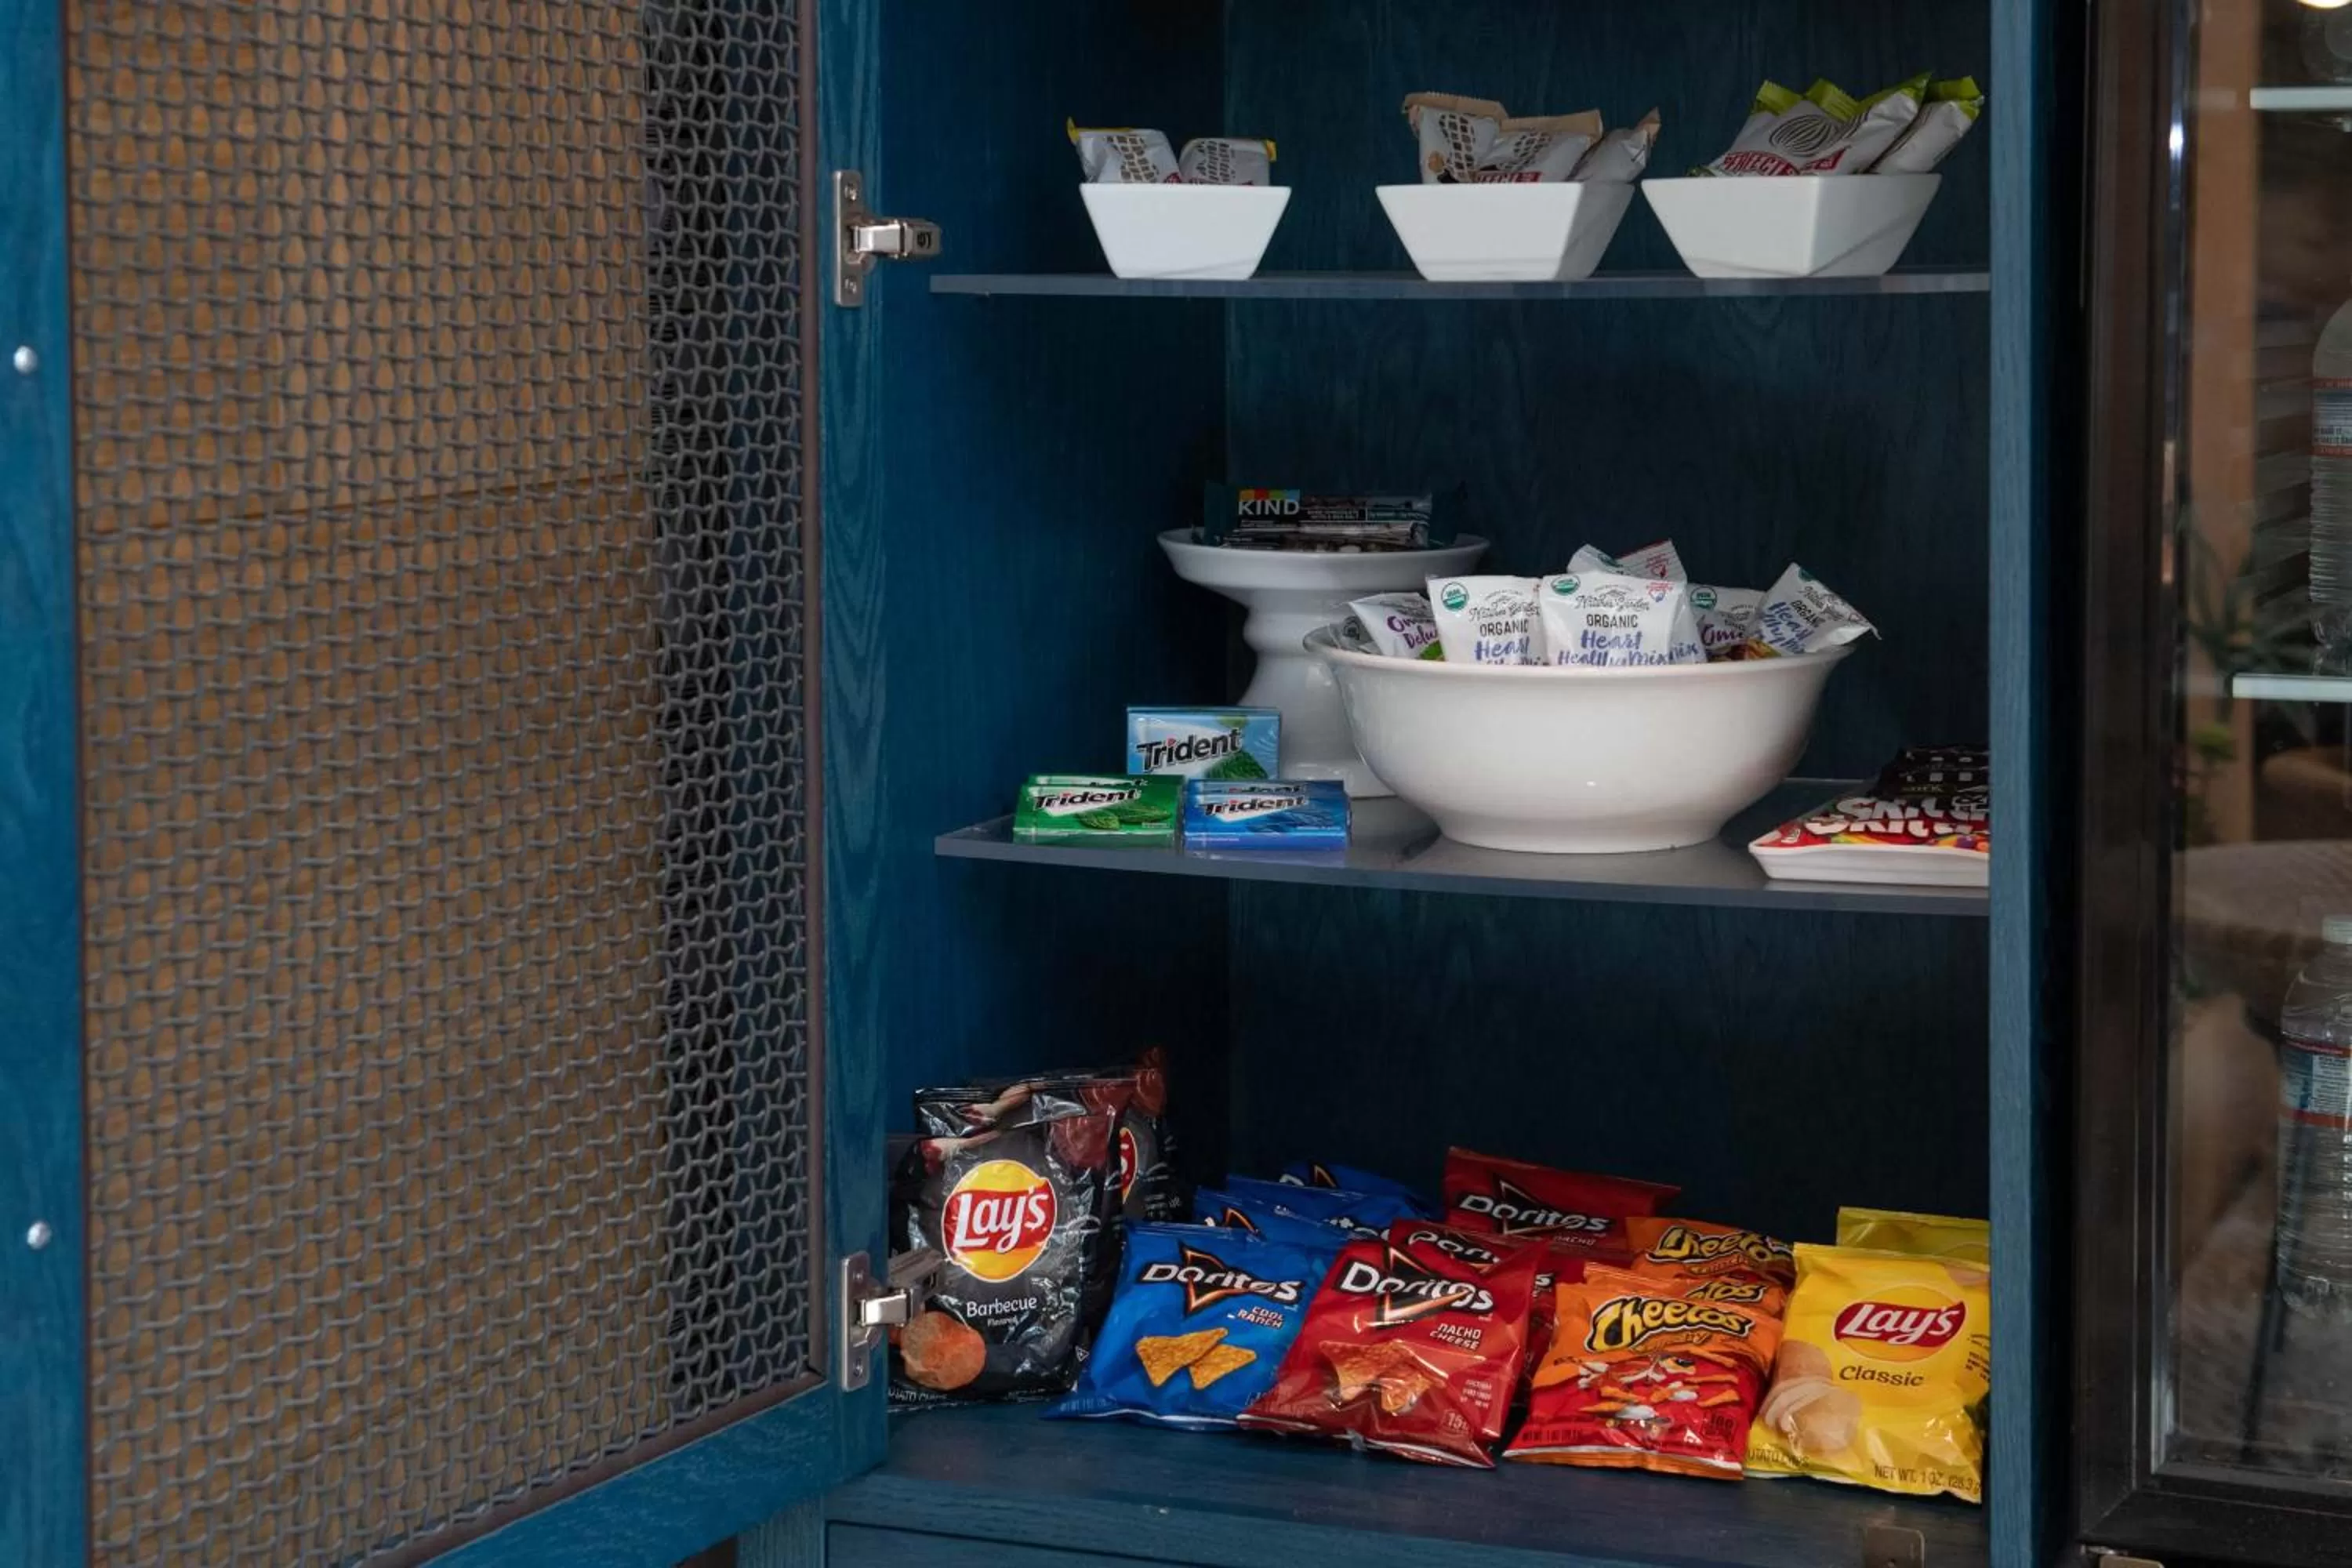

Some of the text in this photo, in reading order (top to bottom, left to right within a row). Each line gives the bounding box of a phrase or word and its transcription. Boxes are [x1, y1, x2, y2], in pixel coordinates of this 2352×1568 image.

[1238, 499, 1300, 515] KIND
[1586, 614, 1639, 628] ORGANIC
[1581, 630, 1644, 649] Heart
[1137, 728, 1243, 771] Trident
[1035, 789, 1139, 809] Trident
[1200, 796, 1305, 815] Trident
[952, 1185, 1048, 1254] Lay's
[1459, 1194, 1610, 1231] Doritos
[1141, 1263, 1303, 1301] Doritos
[1339, 1261, 1494, 1312] Doritos
[966, 1298, 1037, 1318] Barbecue
[1252, 1306, 1283, 1321] COOL
[1238, 1308, 1283, 1329] RANCH
[1587, 1297, 1750, 1352] Cheetos
[1842, 1303, 1961, 1345] Lay's
[1429, 1330, 1480, 1350] CHEESE
[1437, 1323, 1482, 1340] NACHO
[1838, 1365, 1925, 1387] Classic
[1875, 1463, 1896, 1480] NET
